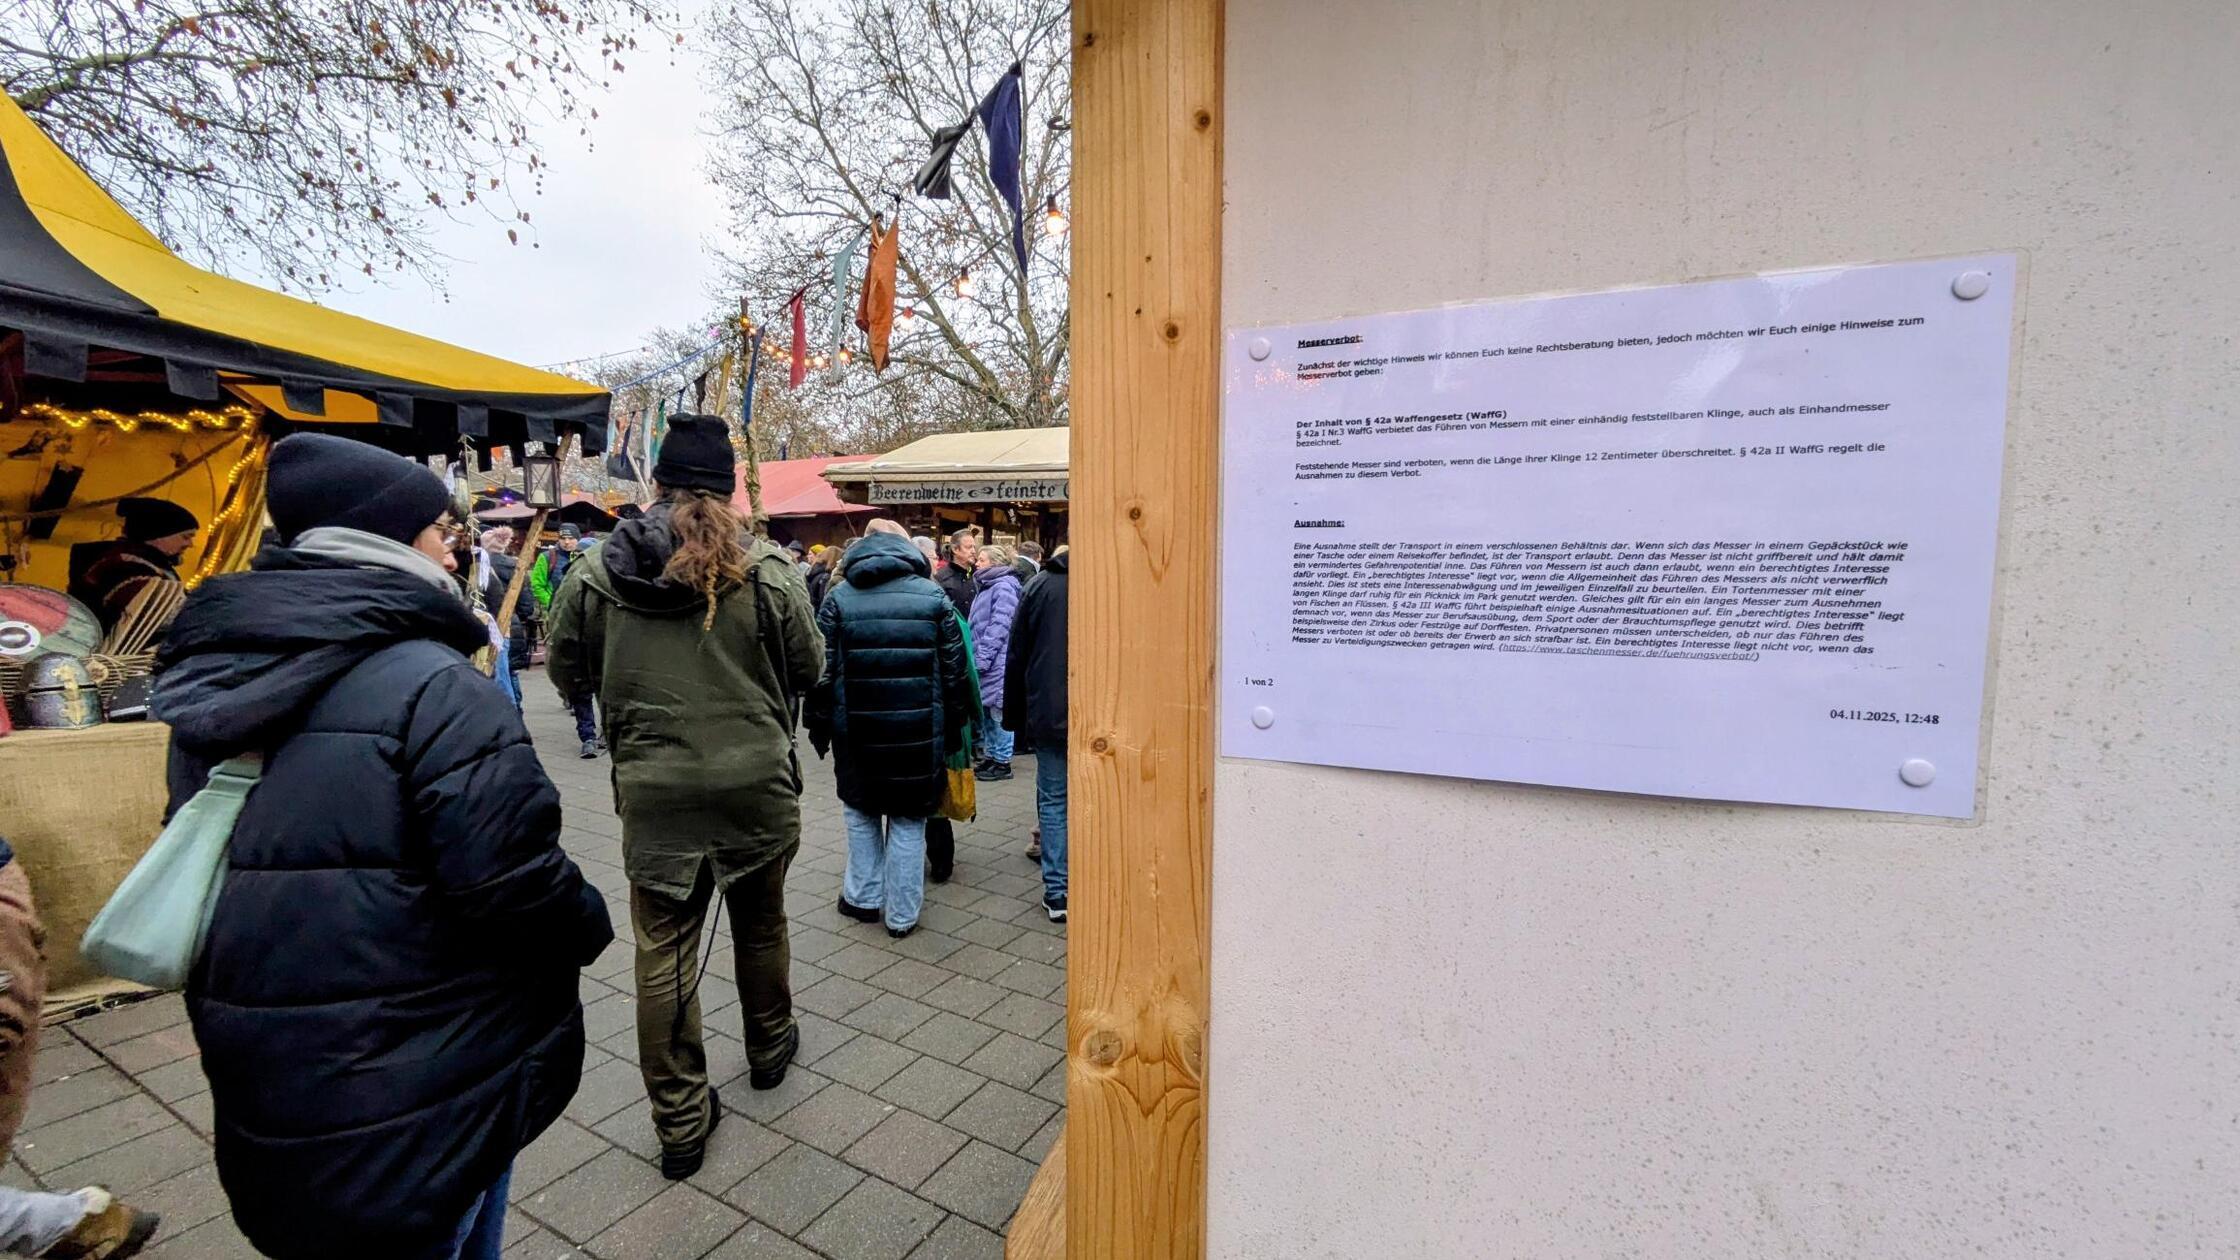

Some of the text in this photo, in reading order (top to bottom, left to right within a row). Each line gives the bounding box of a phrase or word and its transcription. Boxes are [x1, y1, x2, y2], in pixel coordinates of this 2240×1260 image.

[1297, 334, 1364, 349] Messerverbot:
[1297, 361, 1334, 371] Zunächst
[1353, 358, 1388, 369] wichtige
[1391, 355, 1424, 363] Hinweis
[1427, 352, 1441, 360] wir
[1445, 351, 1478, 359] können
[1482, 348, 1504, 357] Euch
[1507, 346, 1532, 354] keine
[1536, 340, 1613, 352] Rechtsberatung
[1617, 338, 1652, 346] bieten,
[1656, 333, 1692, 345] jedoch
[1696, 330, 1743, 340] möchten
[1747, 327, 1765, 336] wir
[1769, 325, 1797, 335] Euch
[1801, 323, 1836, 333] einige
[1840, 319, 1894, 329] Hinweise
[1898, 317, 1924, 326] zum
[1297, 364, 1382, 380] Messerverbot geben:
[1304, 429, 1319, 437] 42a
[1328, 427, 1344, 435] Nr.3
[1347, 424, 1372, 435] WaffG
[1375, 425, 1413, 433] verbietet
[1416, 421, 1432, 432] das
[1435, 423, 1466, 431] Führen
[1550, 418, 1575, 426] einer
[1578, 414, 1627, 424] einhändig
[1631, 412, 1703, 421] feststellbaren
[1707, 409, 1743, 419] Klinge,
[1748, 407, 1774, 416] auch
[1778, 406, 1794, 415] als
[1799, 403, 1890, 414] Einhandmesser
[1315, 419, 1342, 427] Inhalt
[1365, 417, 1370, 428] §
[1374, 416, 1391, 424] 42a
[1394, 413, 1462, 425] Waffengesetz
[1466, 410, 1506, 423] (WaffG)
[1296, 438, 1341, 447] bezeichnet.
[1295, 462, 1349, 470] Feststehende
[1383, 460, 1401, 468] sind
[1476, 456, 1491, 464] die
[1494, 456, 1522, 465] Länge
[1551, 454, 1581, 463] Klinge
[1585, 452, 1597, 461] 12
[1601, 451, 1658, 460] Zentimeter
[1661, 448, 1735, 457] überschreitet.
[1740, 447, 1746, 457] §
[1750, 446, 1771, 455] 42a
[1775, 446, 1784, 454] II
[1789, 444, 1823, 454] WaffG
[1828, 443, 1862, 454] regelt
[1867, 442, 1885, 451] die
[1295, 468, 1342, 479] Ausnahmen
[1357, 470, 1387, 478] diesem
[1390, 469, 1421, 477] Verbot.
[872, 482, 964, 501] Beerenweine
[997, 480, 1056, 499] feinste
[1294, 519, 1345, 528] Ausnahme:
[1293, 542, 1311, 550] Eine
[1400, 542, 1441, 552] Transport
[1610, 541, 1629, 549] dar.
[1635, 541, 1664, 549] Wenn
[1667, 541, 1688, 549] sich
[1691, 541, 1710, 549] das
[1713, 541, 1752, 549] Messer
[1755, 541, 1764, 549] in
[1768, 541, 1803, 549] einem
[1808, 541, 1883, 550] Gepäckstück
[1887, 541, 1908, 550] wie
[1397, 551, 1445, 559] Reisekoffer
[1449, 551, 1488, 560] befindet,
[1526, 551, 1571, 561] Transport
[1617, 551, 1644, 560] Denn
[1670, 552, 1706, 560] Messer
[1709, 552, 1722, 560] ist
[1726, 552, 1752, 560] nicht
[1756, 552, 1812, 562] griffbereit
[1816, 552, 1838, 560] und
[1842, 552, 1865, 560] hält
[1869, 552, 1904, 561] damit
[1364, 561, 1441, 569] Gefahrenpotential
[1546, 562, 1586, 570] Messern
[1662, 563, 1701, 571] erlaubt,
[1759, 564, 1829, 574] berechtigtes
[1833, 564, 1889, 573] Interesse
[1392, 610, 1422, 618] Messer
[1442, 612, 1517, 622] Berufsausübung,
[1546, 614, 1572, 623] Sport
[1602, 616, 1618, 624] der
[1622, 616, 1715, 627] Brauchtumspflege
[1719, 620, 1760, 628] genutzt
[1796, 620, 1819, 629] Dies
[1824, 621, 1864, 630] betrifft
[1292, 635, 1319, 643] Messer
[1335, 637, 1427, 647] Verteidigungszwecken
[1430, 642, 1470, 650] getragen
[1245, 677, 1248, 685] 1
[1268, 678, 1273, 686] 2
[1830, 709, 1939, 724] 04.11.2025, 12:48
